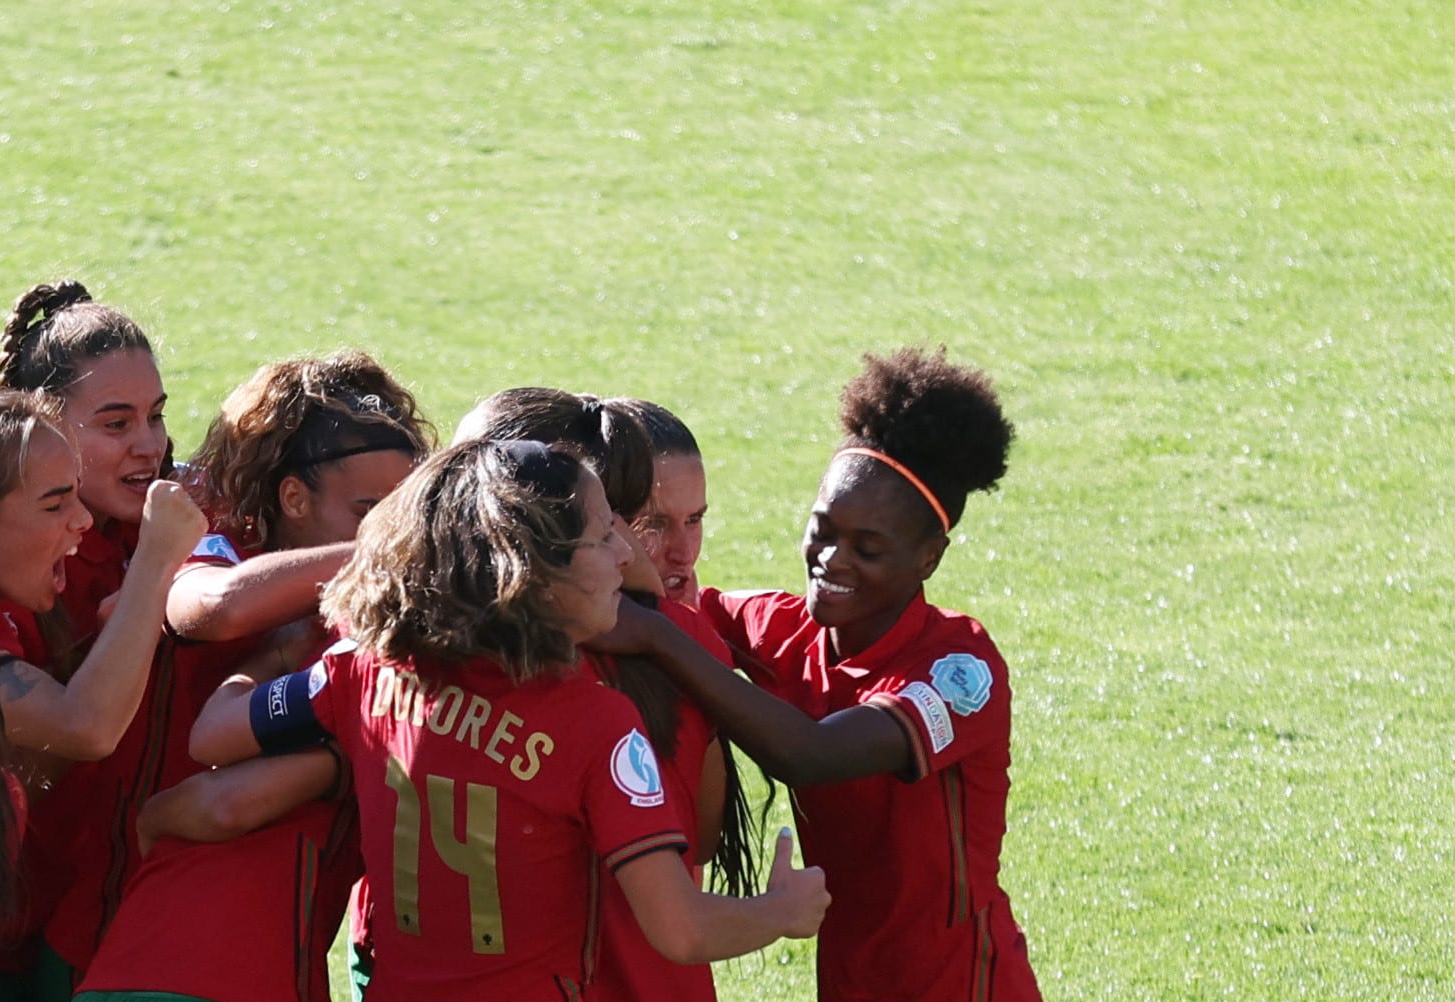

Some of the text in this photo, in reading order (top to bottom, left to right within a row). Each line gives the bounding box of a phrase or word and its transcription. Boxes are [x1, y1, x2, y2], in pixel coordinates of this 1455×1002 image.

[271, 674, 290, 716] ESPECT
[371, 666, 555, 781] DOLORES
[385, 754, 505, 954] 14
